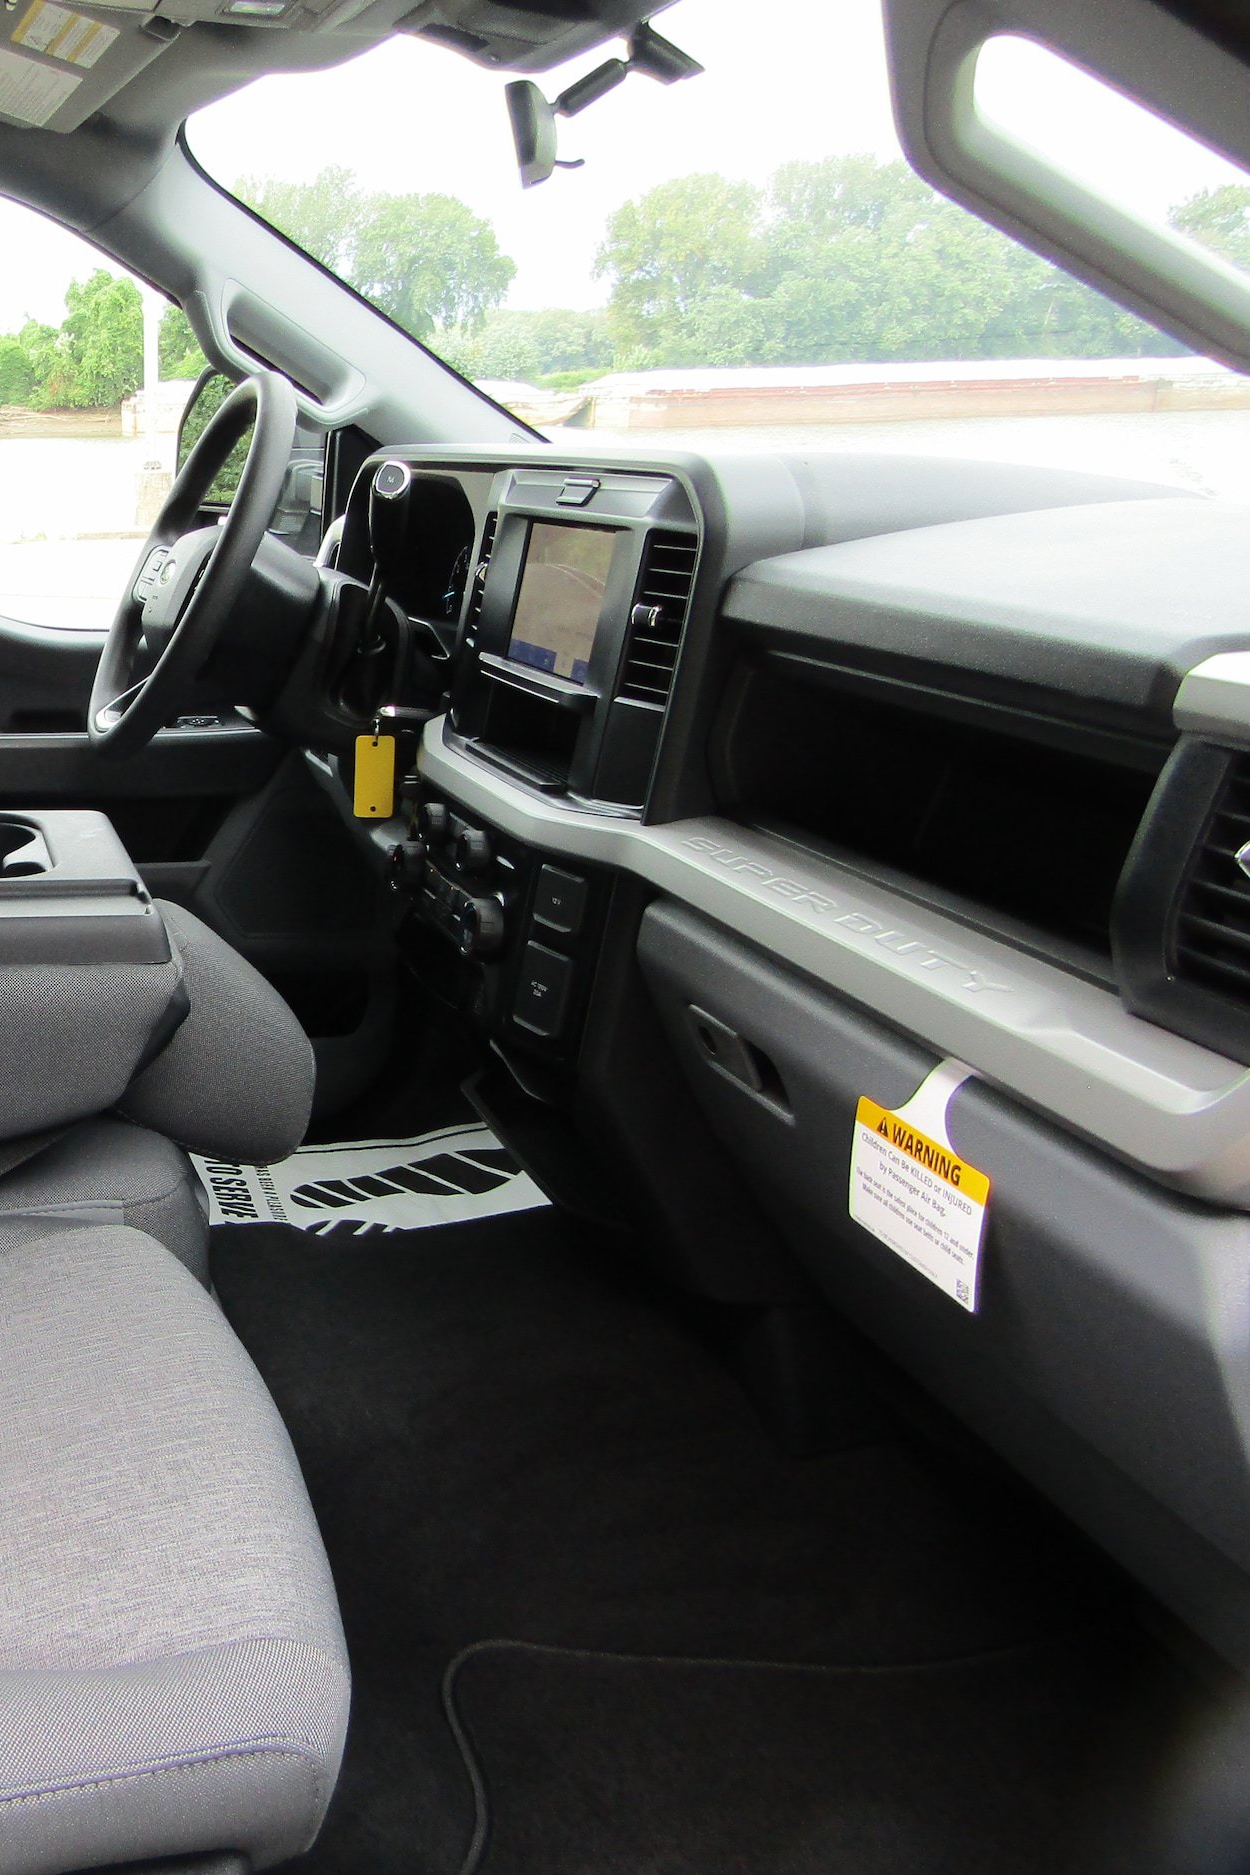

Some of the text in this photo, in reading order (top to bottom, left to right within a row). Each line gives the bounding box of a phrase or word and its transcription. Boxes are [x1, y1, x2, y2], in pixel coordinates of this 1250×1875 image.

[681, 836, 1014, 994] SUPER DUTY
[861, 1131, 971, 1218] Children Can Be KILLED or INJURED
[892, 1123, 961, 1187] WARNING
[210, 1177, 259, 1218] SERVE
[258, 1177, 275, 1191] BEEN
[878, 1160, 887, 1176] by
[888, 1167, 919, 1199] Passenger
[920, 1190, 930, 1204] Air
[265, 1195, 288, 1222] PLEASURE
